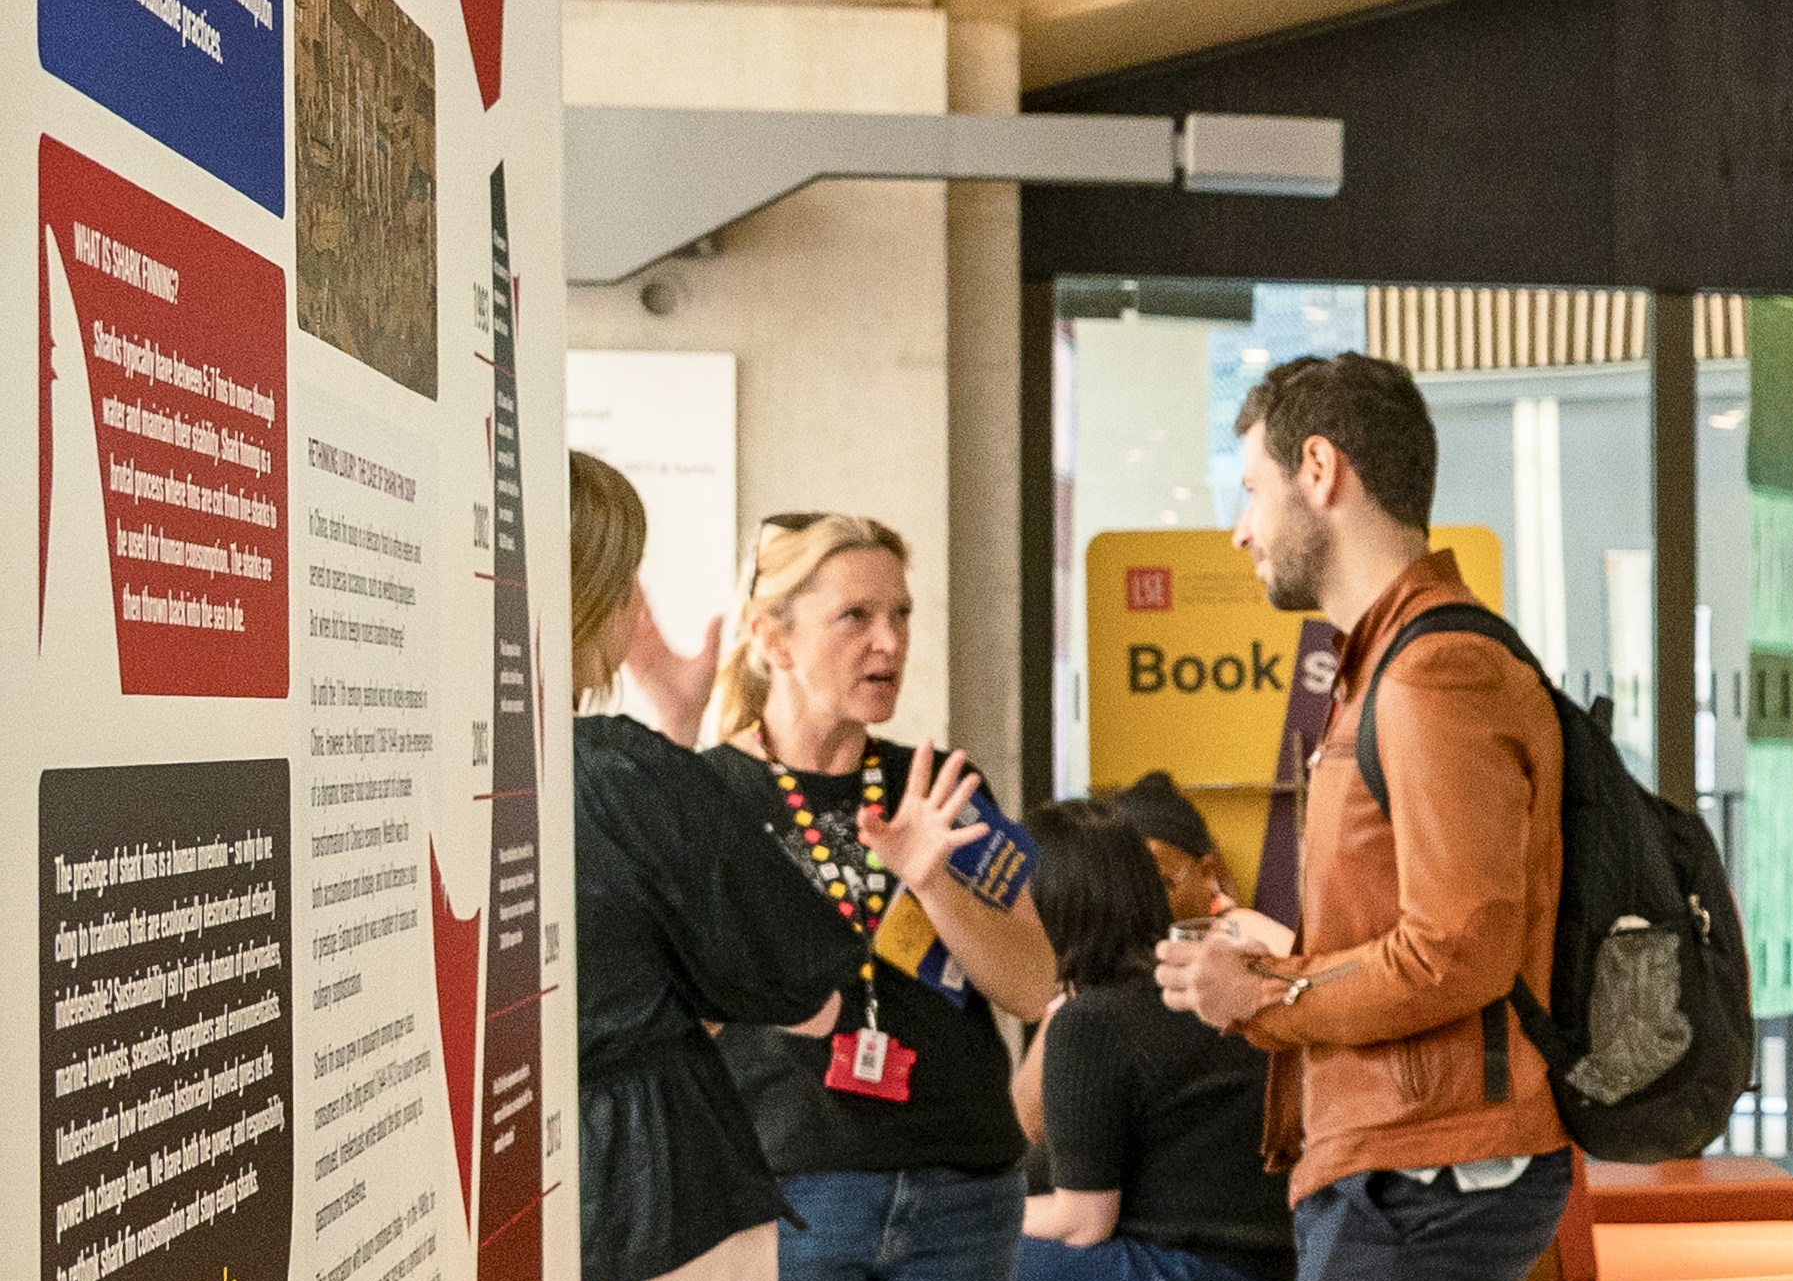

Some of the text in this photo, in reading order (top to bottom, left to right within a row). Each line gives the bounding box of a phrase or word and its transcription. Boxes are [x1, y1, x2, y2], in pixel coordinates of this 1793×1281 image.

[182, 4, 223, 64] practices.
[73, 221, 179, 304] WHAT IS SHARK FINNING?
[1127, 641, 1284, 695] Book
